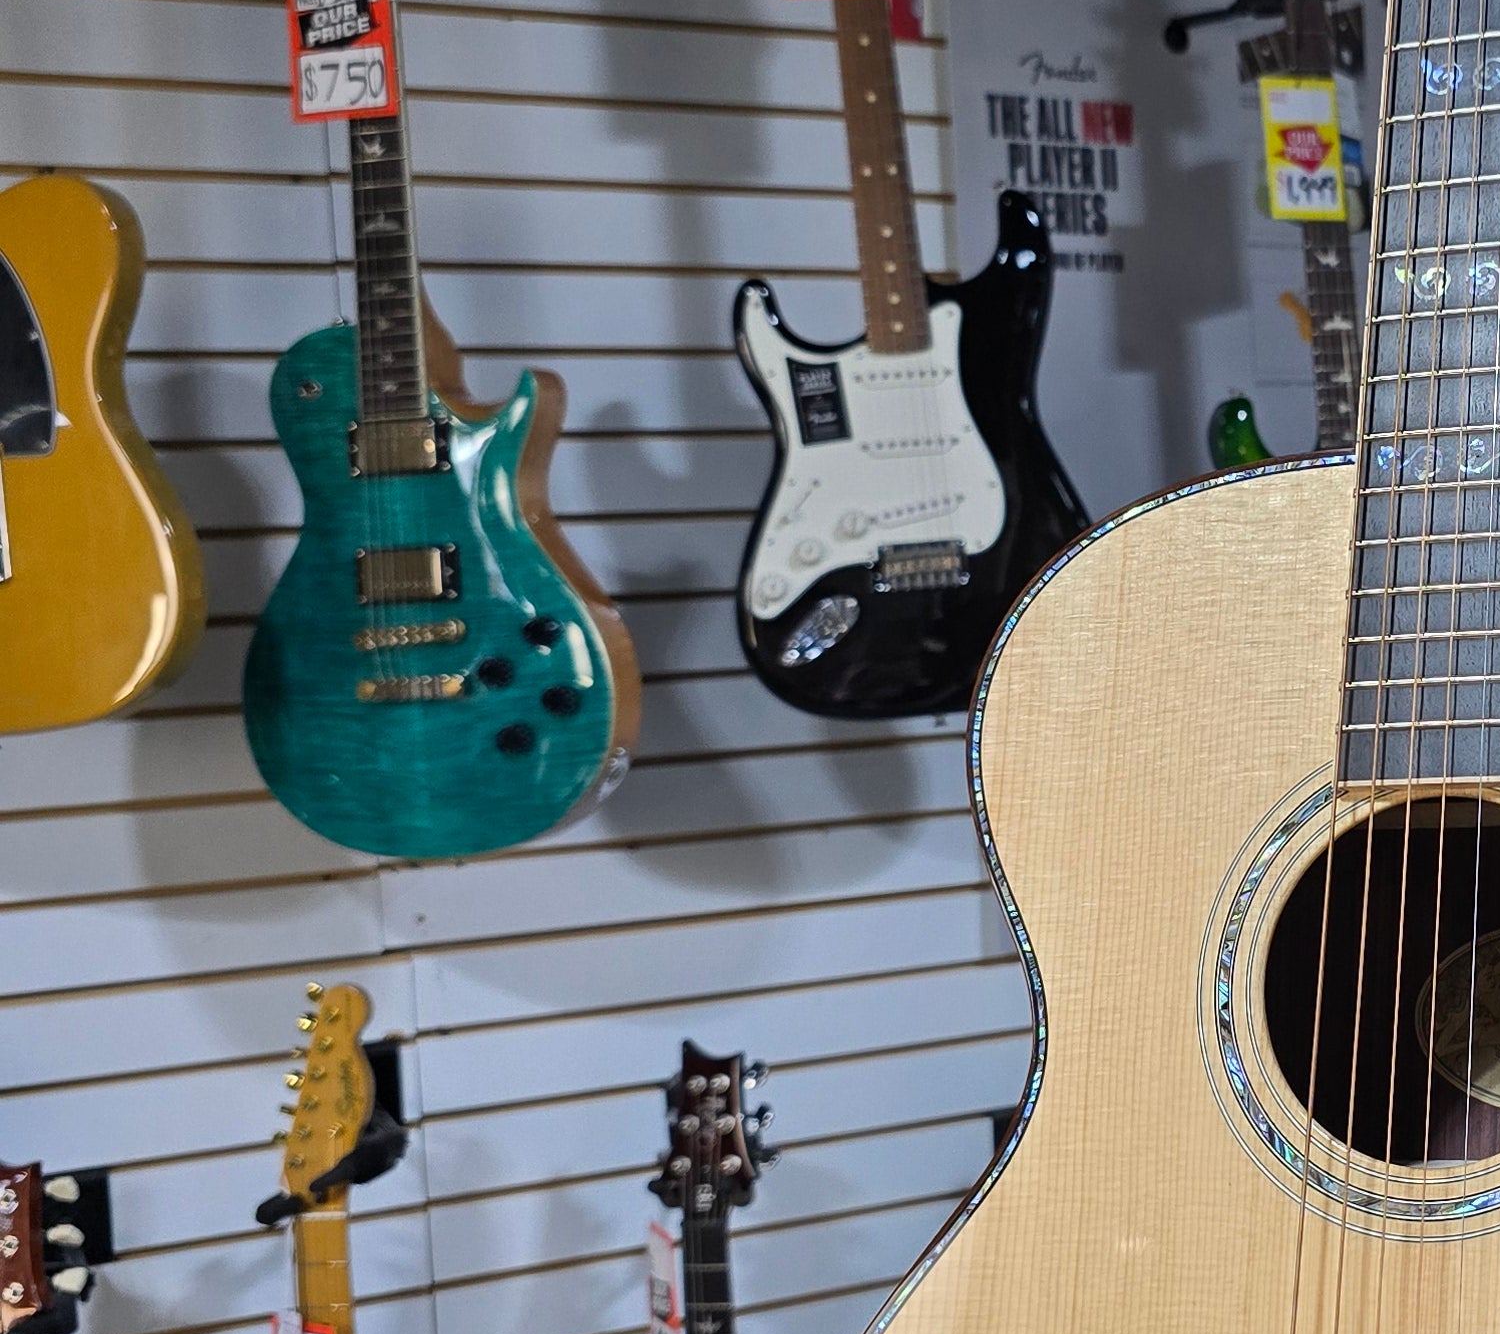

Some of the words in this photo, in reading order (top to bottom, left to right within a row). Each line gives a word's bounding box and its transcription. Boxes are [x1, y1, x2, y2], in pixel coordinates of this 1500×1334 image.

[307, 17, 371, 48] PRICE
[312, 3, 357, 28] OUR
[304, 59, 384, 105] $750
[986, 92, 1030, 139] THE
[1038, 96, 1077, 142] ALL
[1081, 100, 1134, 146] NEW
[1009, 143, 1096, 190] PLAYER
